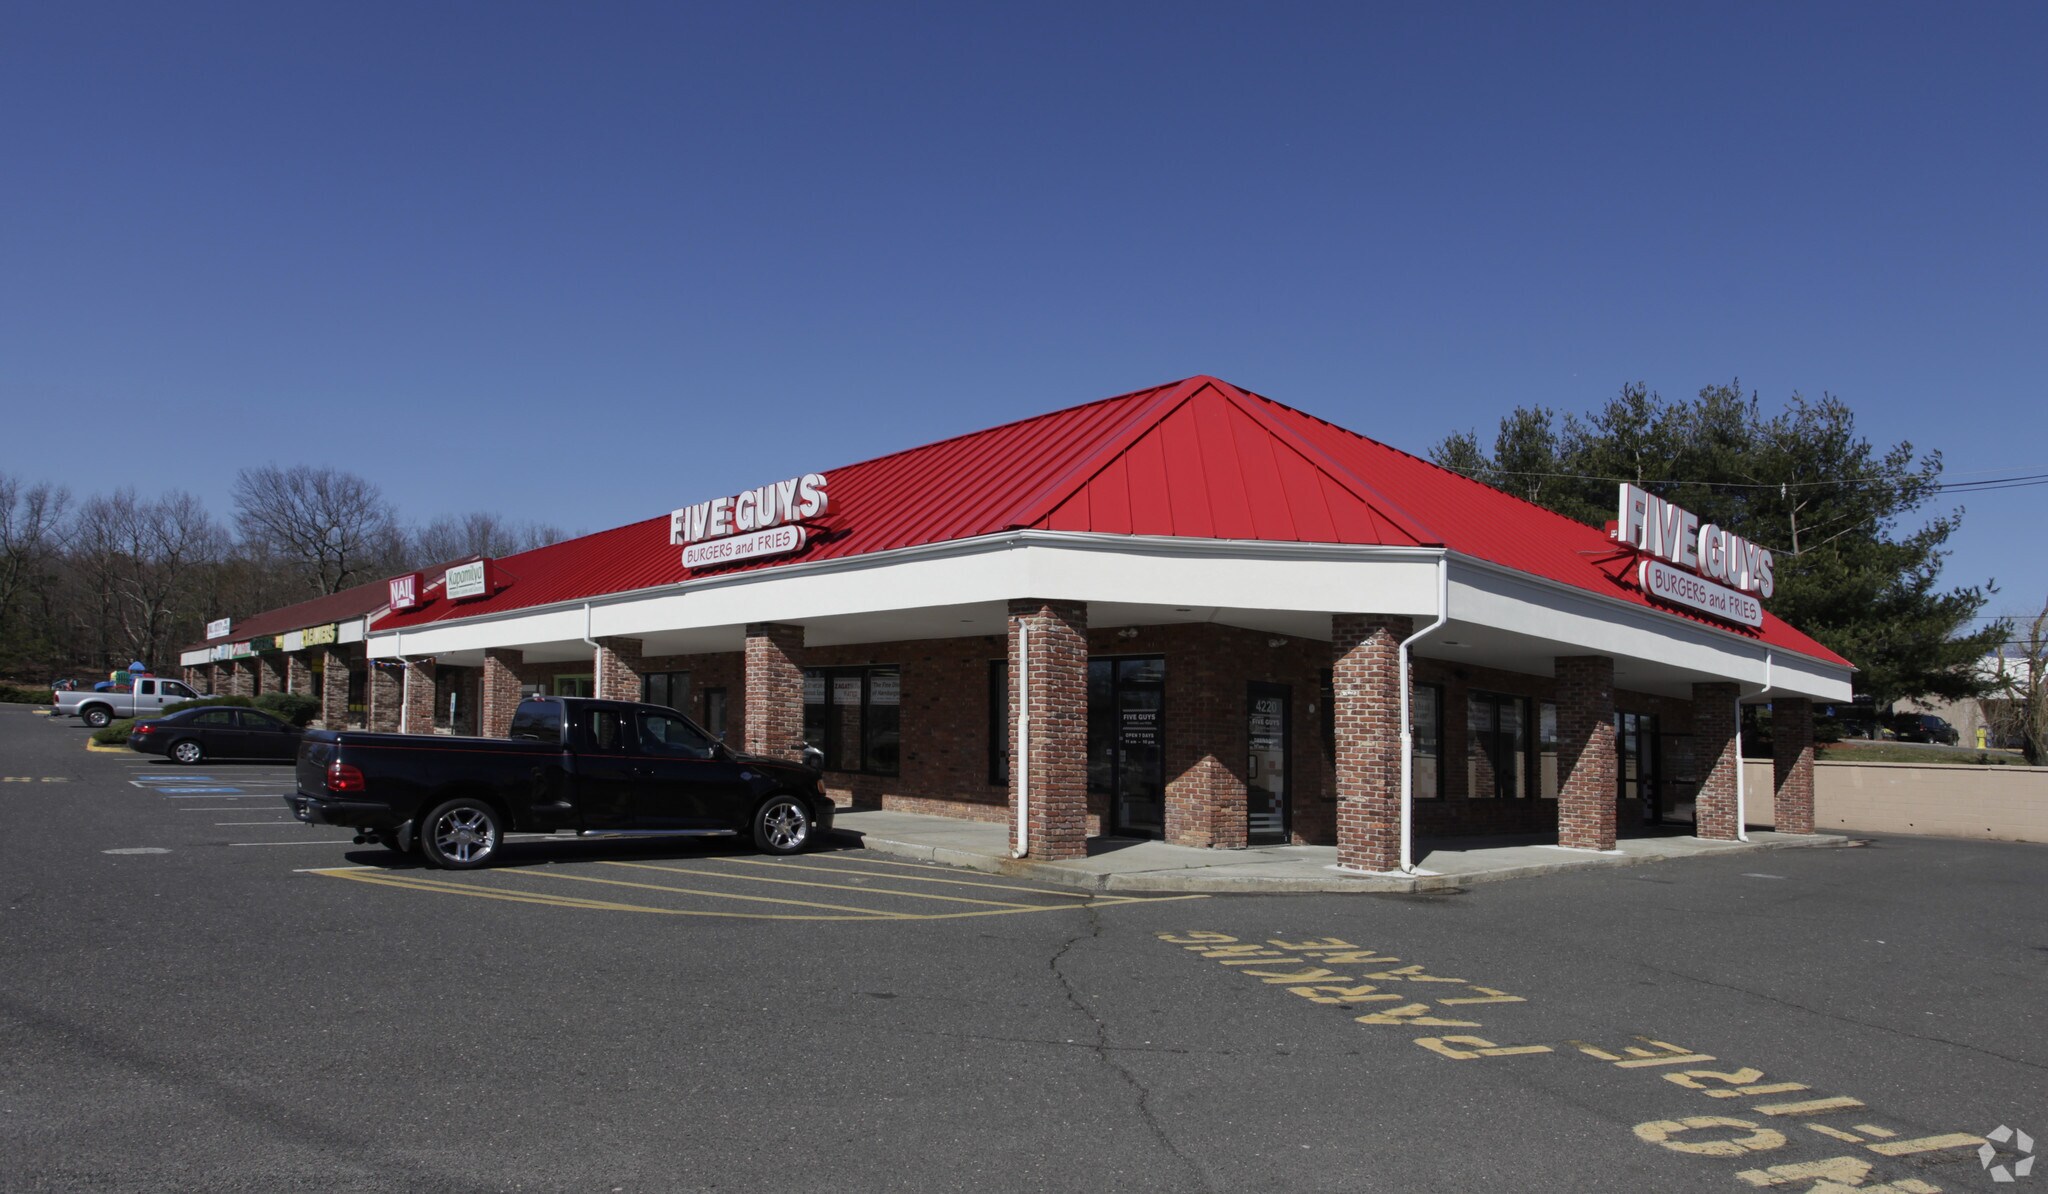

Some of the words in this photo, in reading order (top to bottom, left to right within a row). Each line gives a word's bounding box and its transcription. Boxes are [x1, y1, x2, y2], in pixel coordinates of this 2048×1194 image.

[670, 497, 735, 545] FIVE
[736, 473, 828, 531] GUYS
[1618, 482, 1699, 568] FIVE
[1699, 523, 1774, 599] GUYS
[687, 542, 733, 564] BURGERS
[735, 538, 754, 555] and
[758, 531, 791, 550] FRIES
[391, 578, 415, 605] NAIL
[1655, 569, 1706, 604] BURGERS
[1709, 593, 1727, 611] and
[1729, 595, 1757, 620] FRIES
[1256, 700, 1277, 713] 4220
[1152, 931, 1554, 1060] PARKING
[1266, 937, 1528, 1006] LANE
[1566, 1035, 1988, 1156] FIRE
